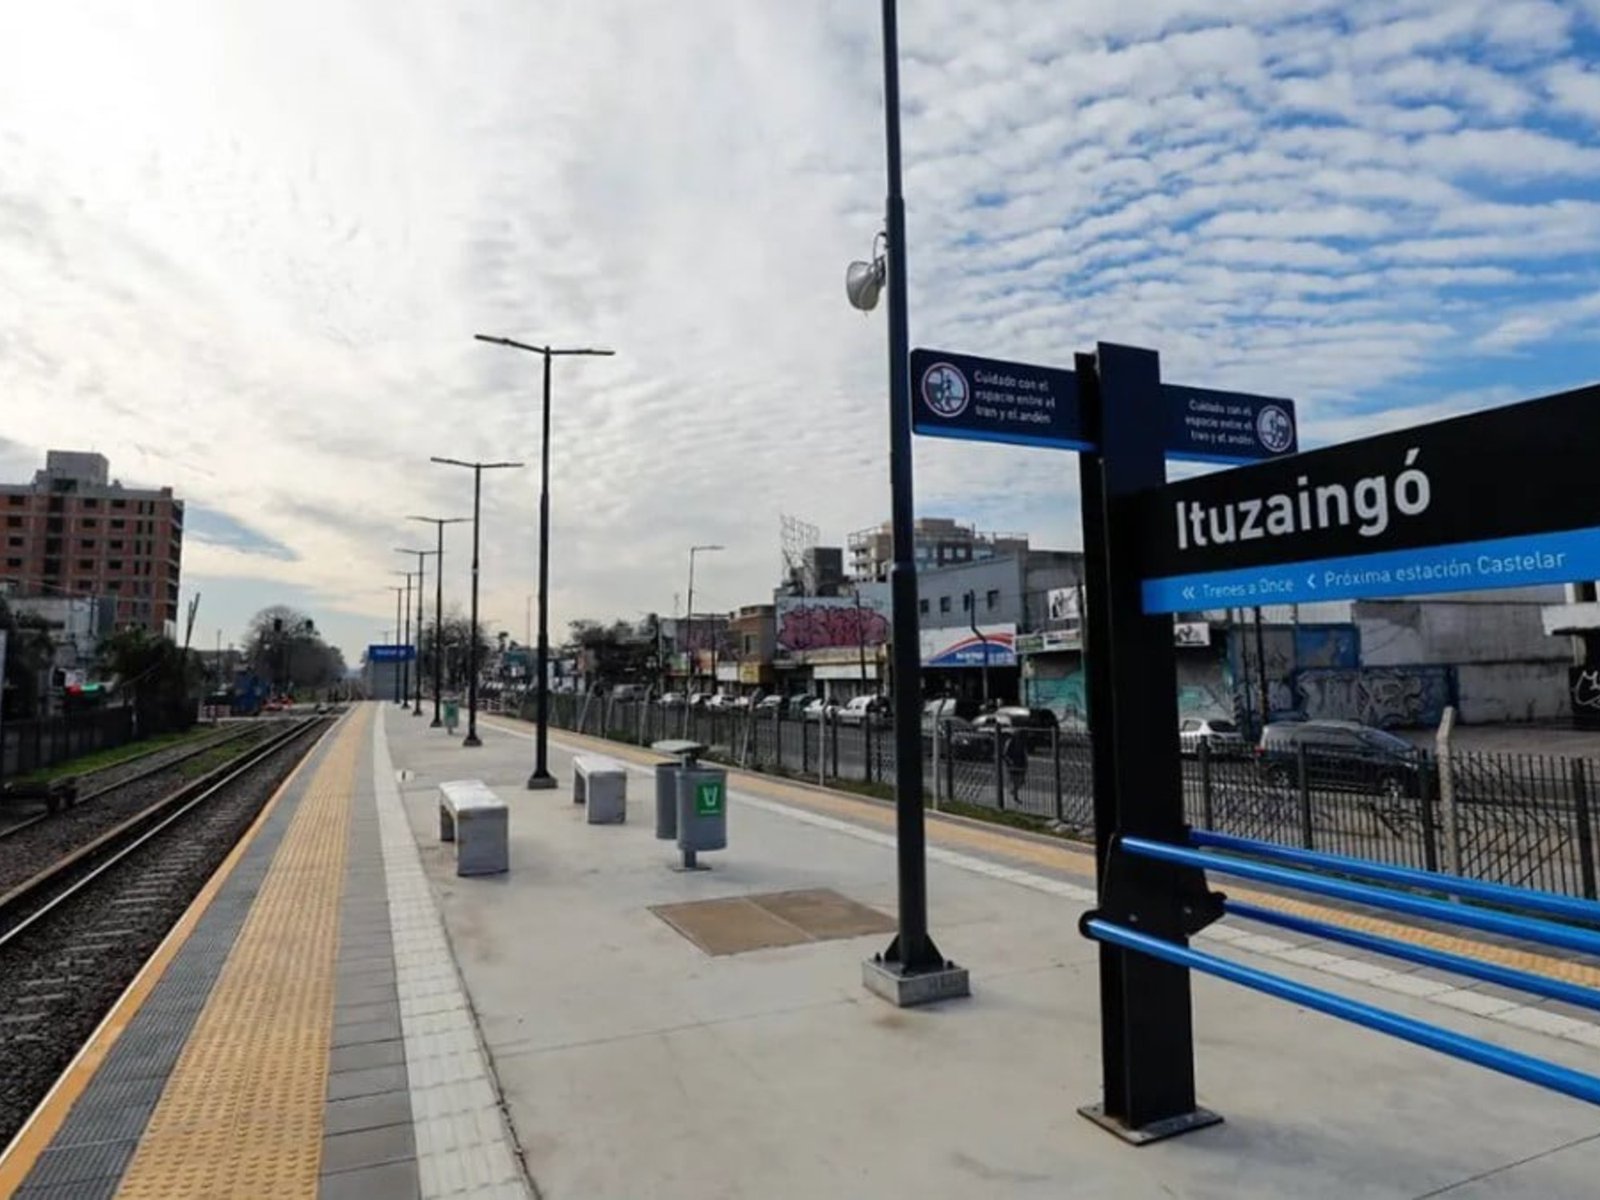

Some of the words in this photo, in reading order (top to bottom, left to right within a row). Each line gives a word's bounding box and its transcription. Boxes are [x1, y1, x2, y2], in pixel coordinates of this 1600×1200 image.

[973, 370, 1016, 387] Cuidado
[1018, 379, 1036, 390] con
[1176, 448, 1432, 550] Ituzaingó
[1325, 568, 1391, 587] Próxima
[1396, 557, 1472, 582] estación
[1477, 551, 1566, 575] Castelar
[1203, 583, 1247, 598] Trenes
[1248, 584, 1257, 596] a
[1259, 577, 1294, 594] Once
